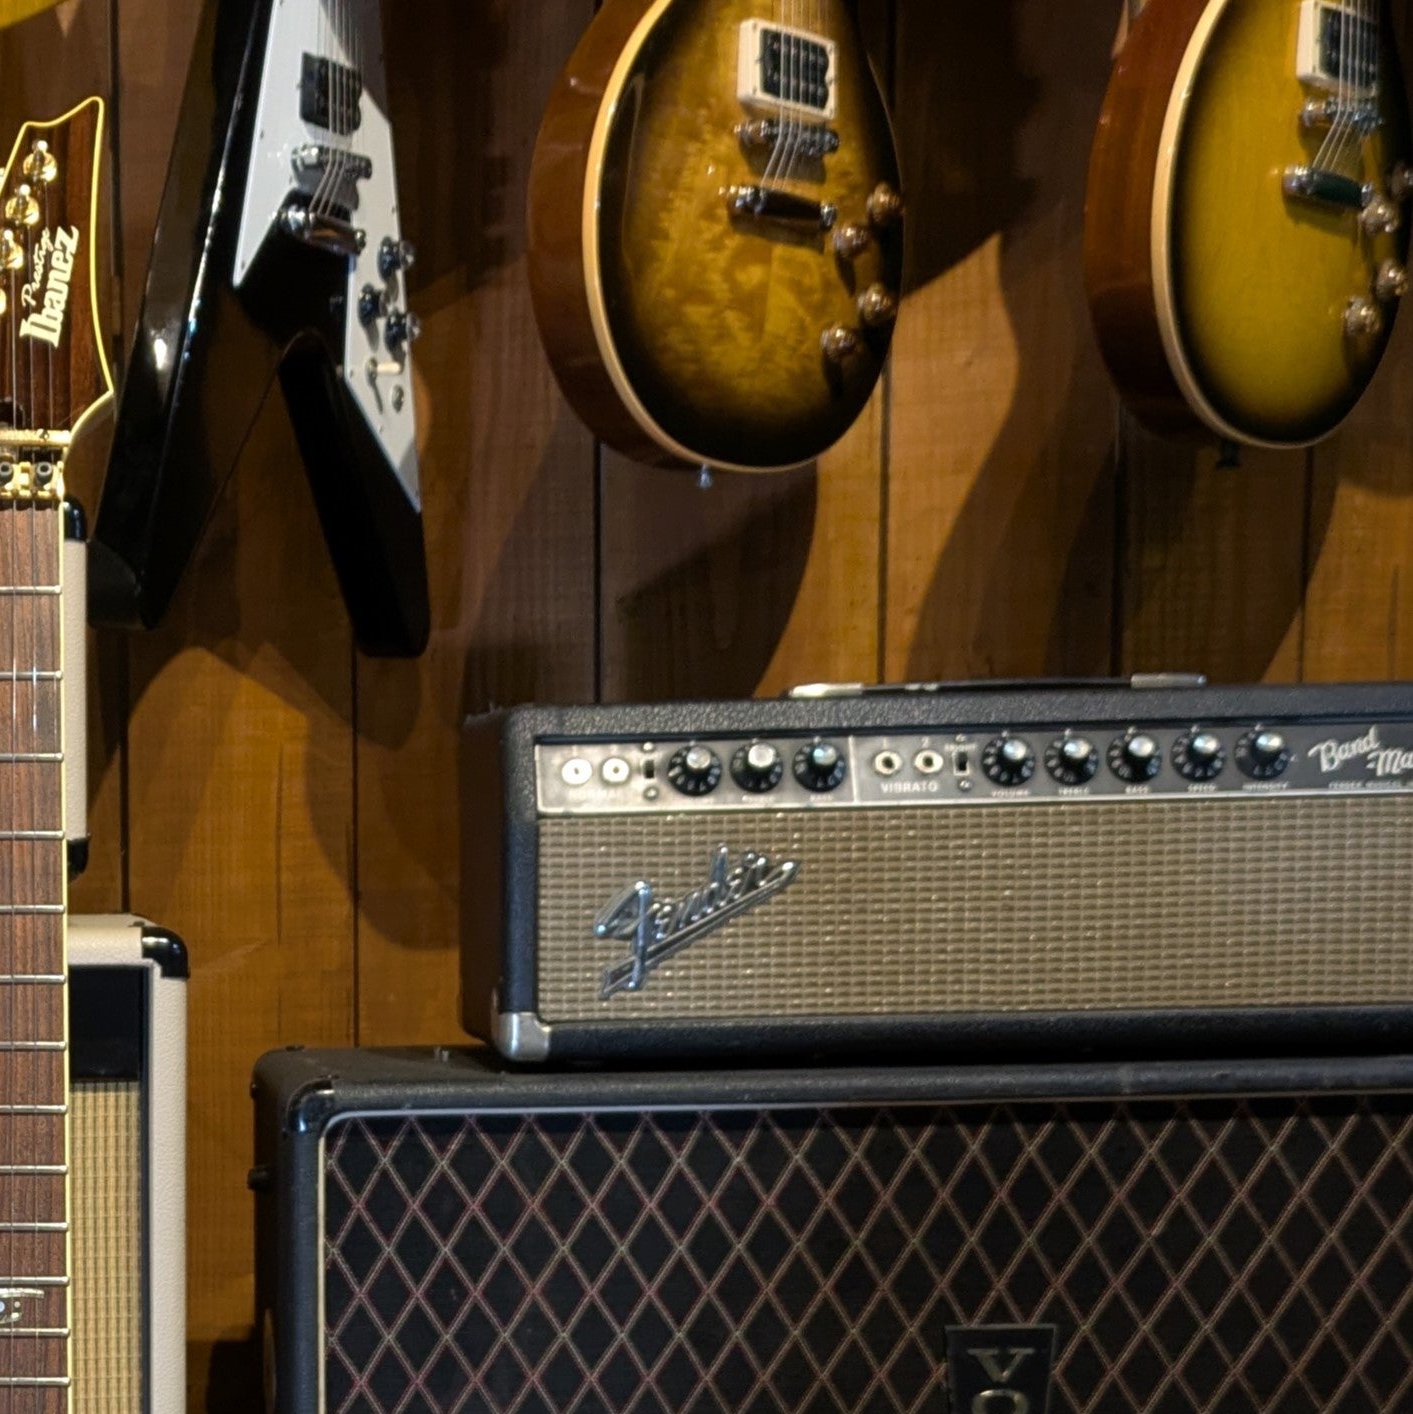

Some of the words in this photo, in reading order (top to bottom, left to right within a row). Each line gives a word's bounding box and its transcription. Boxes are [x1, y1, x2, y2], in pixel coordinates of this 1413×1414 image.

[19, 225, 80, 348] Ibanez
[21, 227, 54, 307] Prestige
[880, 780, 939, 793] VIBRATO
[1307, 724, 1381, 773] Band
[594, 842, 800, 1000] Fender
